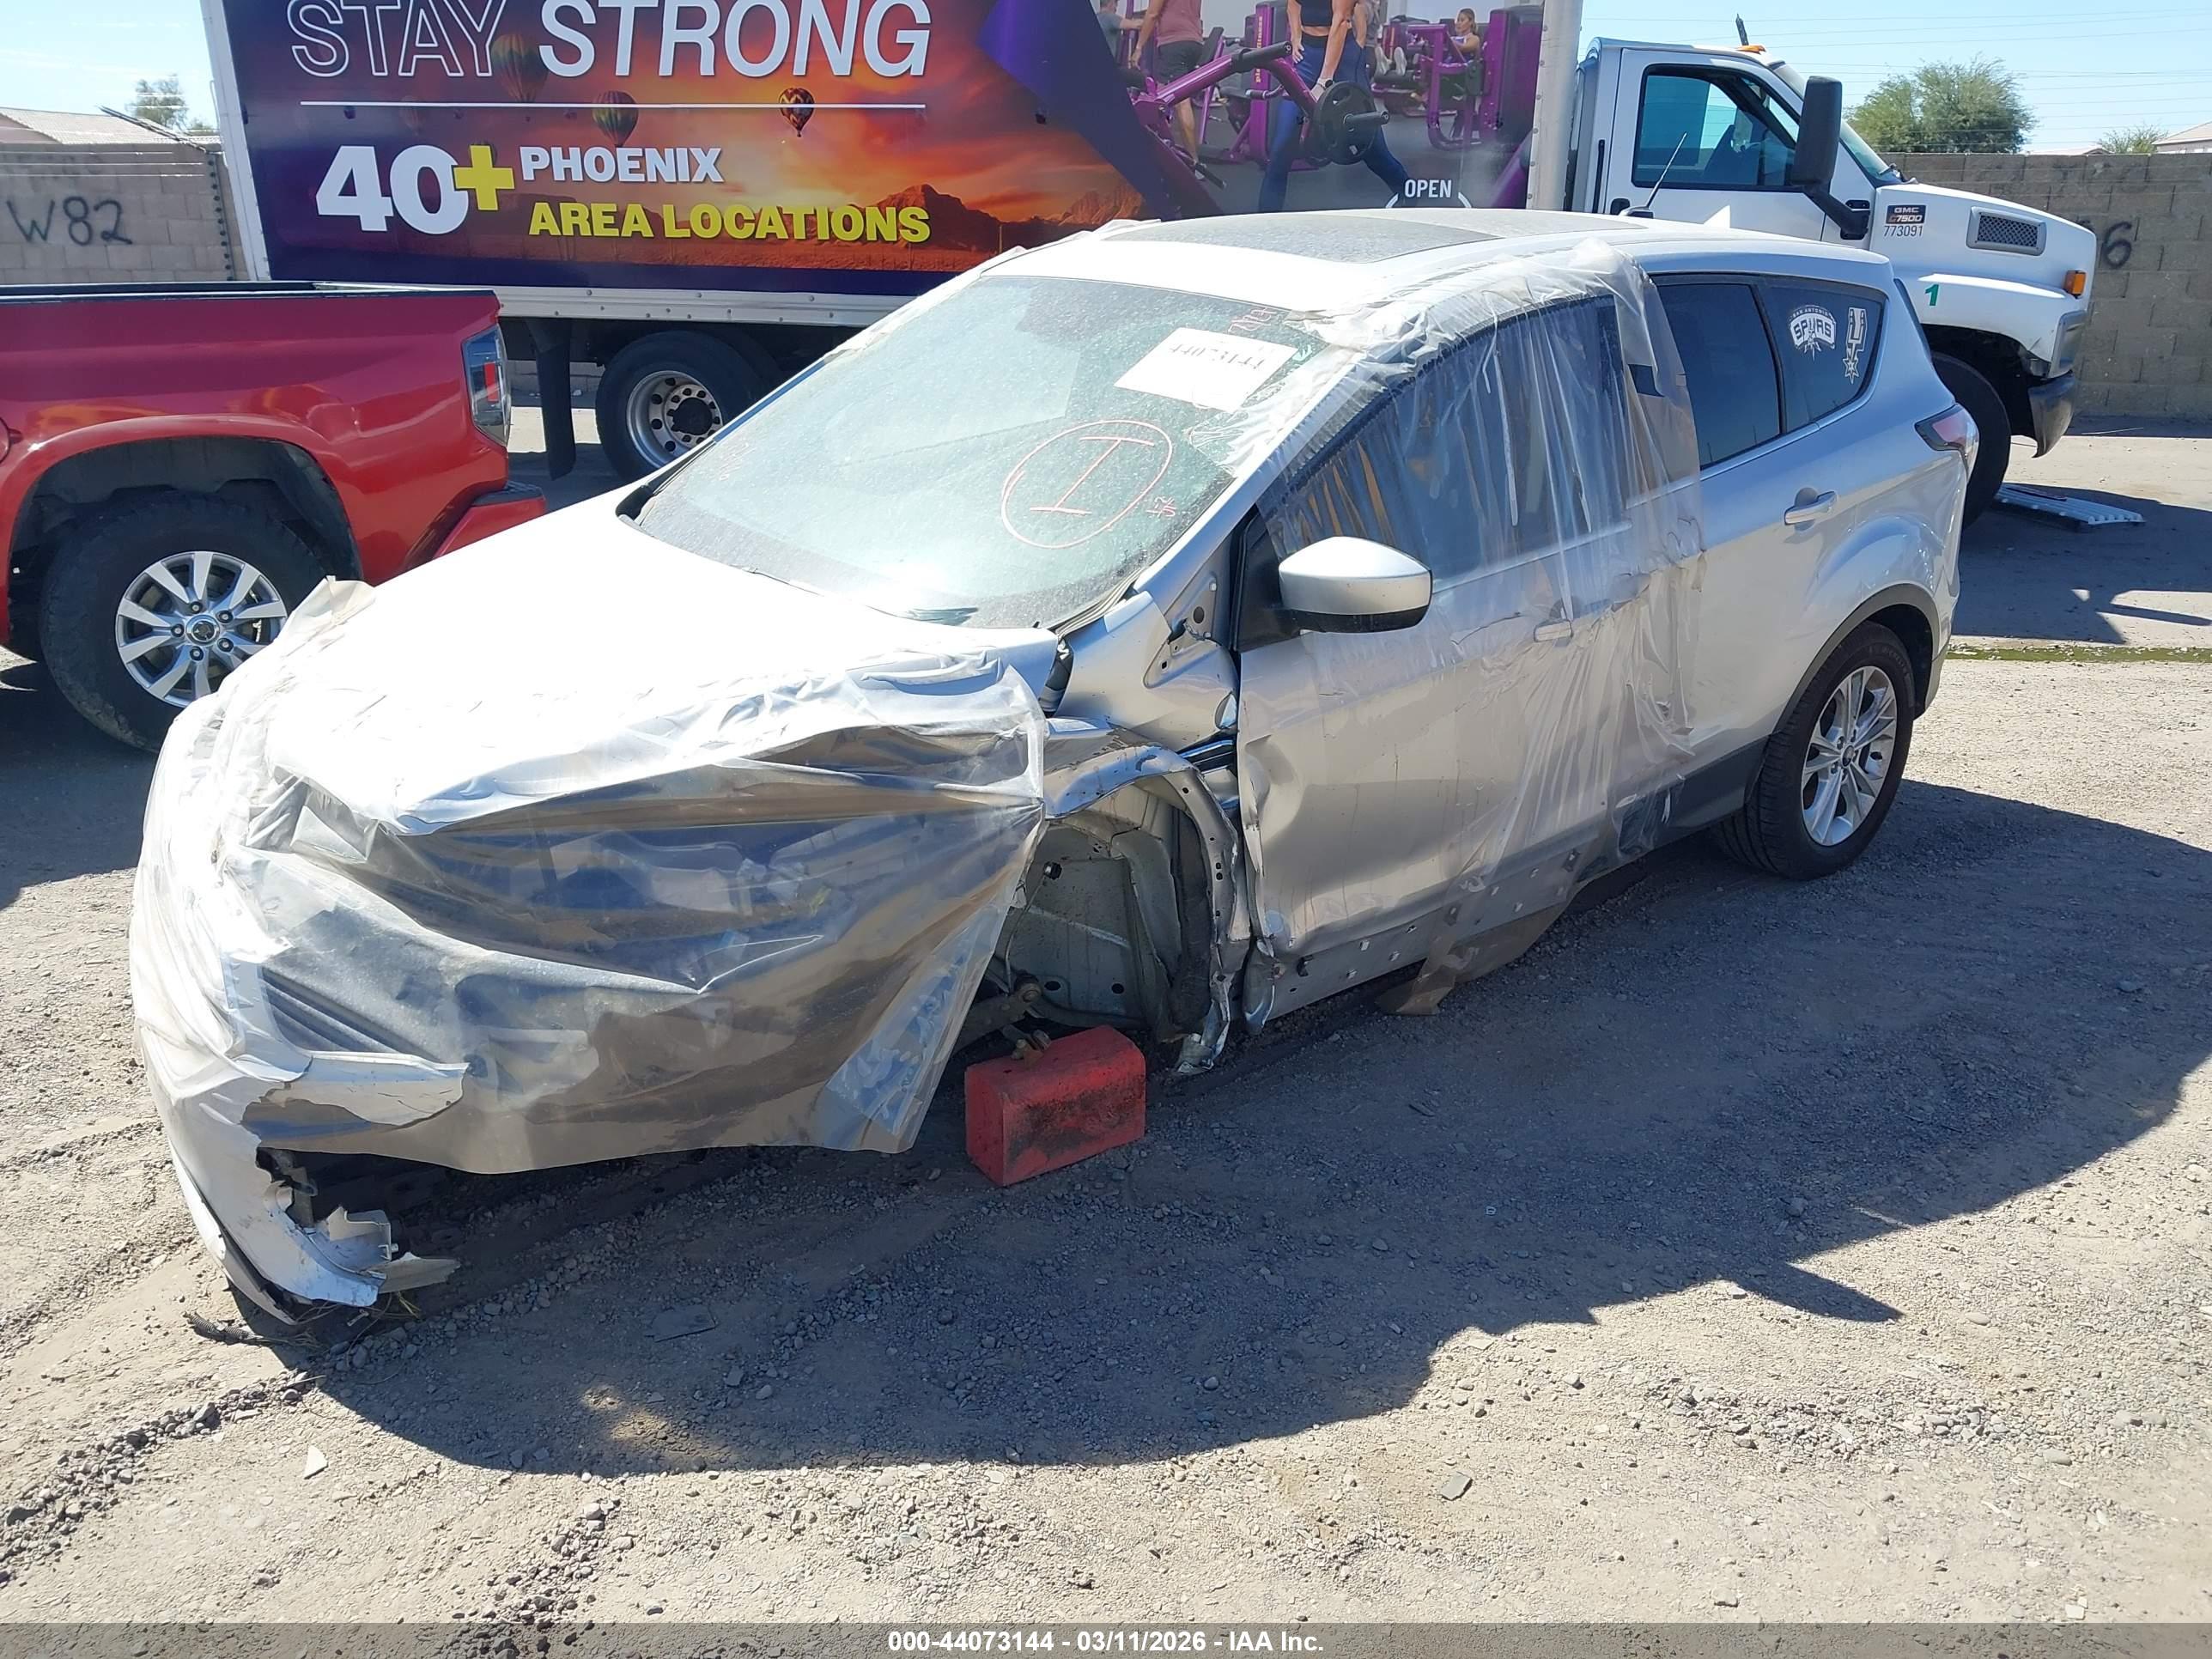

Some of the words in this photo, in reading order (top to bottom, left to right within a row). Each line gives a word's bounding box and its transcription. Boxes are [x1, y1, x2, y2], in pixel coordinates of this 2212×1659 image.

[286, 0, 507, 77] STAY
[538, 0, 933, 77] STRONG
[520, 146, 725, 183] PHOENIX
[315, 144, 515, 234] 40+
[1404, 179, 1452, 198] OPEN
[6, 196, 133, 246] W82
[528, 202, 654, 239] AREA
[663, 204, 931, 243] LOCATIONS
[1883, 225, 1923, 237] 773091
[1924, 283, 1940, 307] 1
[1792, 317, 1832, 341] SPURS
